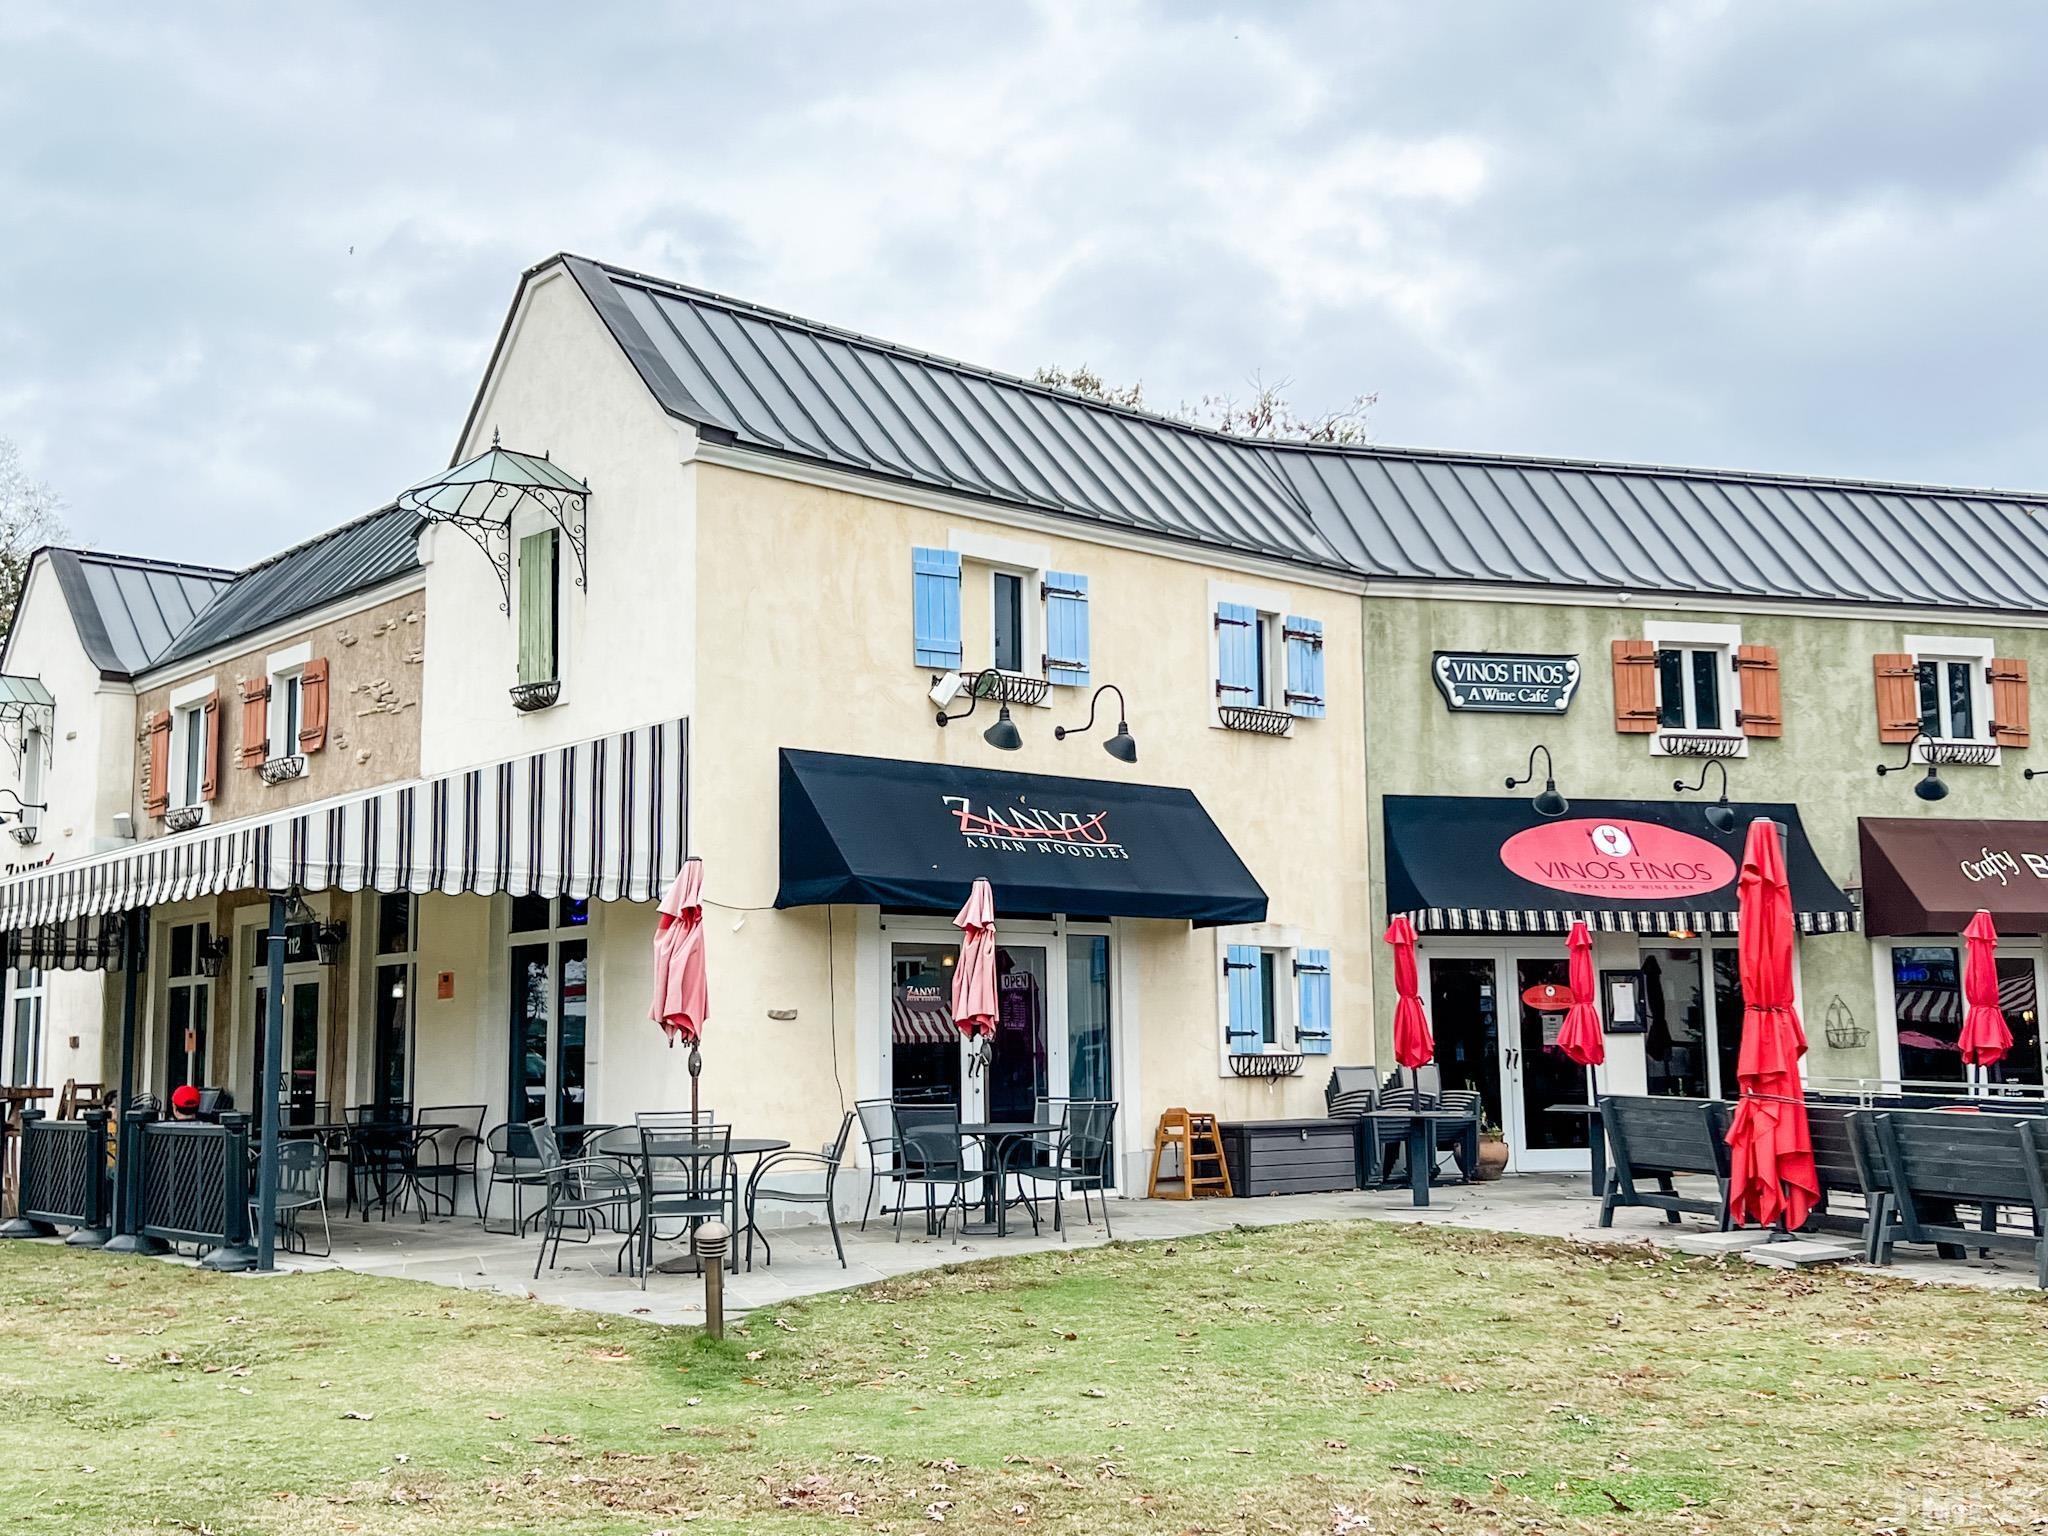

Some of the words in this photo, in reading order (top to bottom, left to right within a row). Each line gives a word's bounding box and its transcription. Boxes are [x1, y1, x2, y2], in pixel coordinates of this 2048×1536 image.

[1452, 662, 1509, 683] VINOS
[1513, 664, 1564, 684] FINOS
[1468, 687, 1481, 701] A
[1481, 687, 1516, 702] Wine
[1518, 688, 1549, 703] Café
[942, 795, 1108, 844] ZANYU
[966, 837, 1027, 853] ASIAN
[1037, 841, 1130, 860] NOODLES
[1534, 860, 1626, 881] VINOS
[1629, 861, 1713, 881] FINOS
[1960, 846, 2021, 887] Crafty
[2020, 852, 2048, 879] B
[287, 936, 301, 955] 112
[1003, 974, 1027, 988] OPEN
